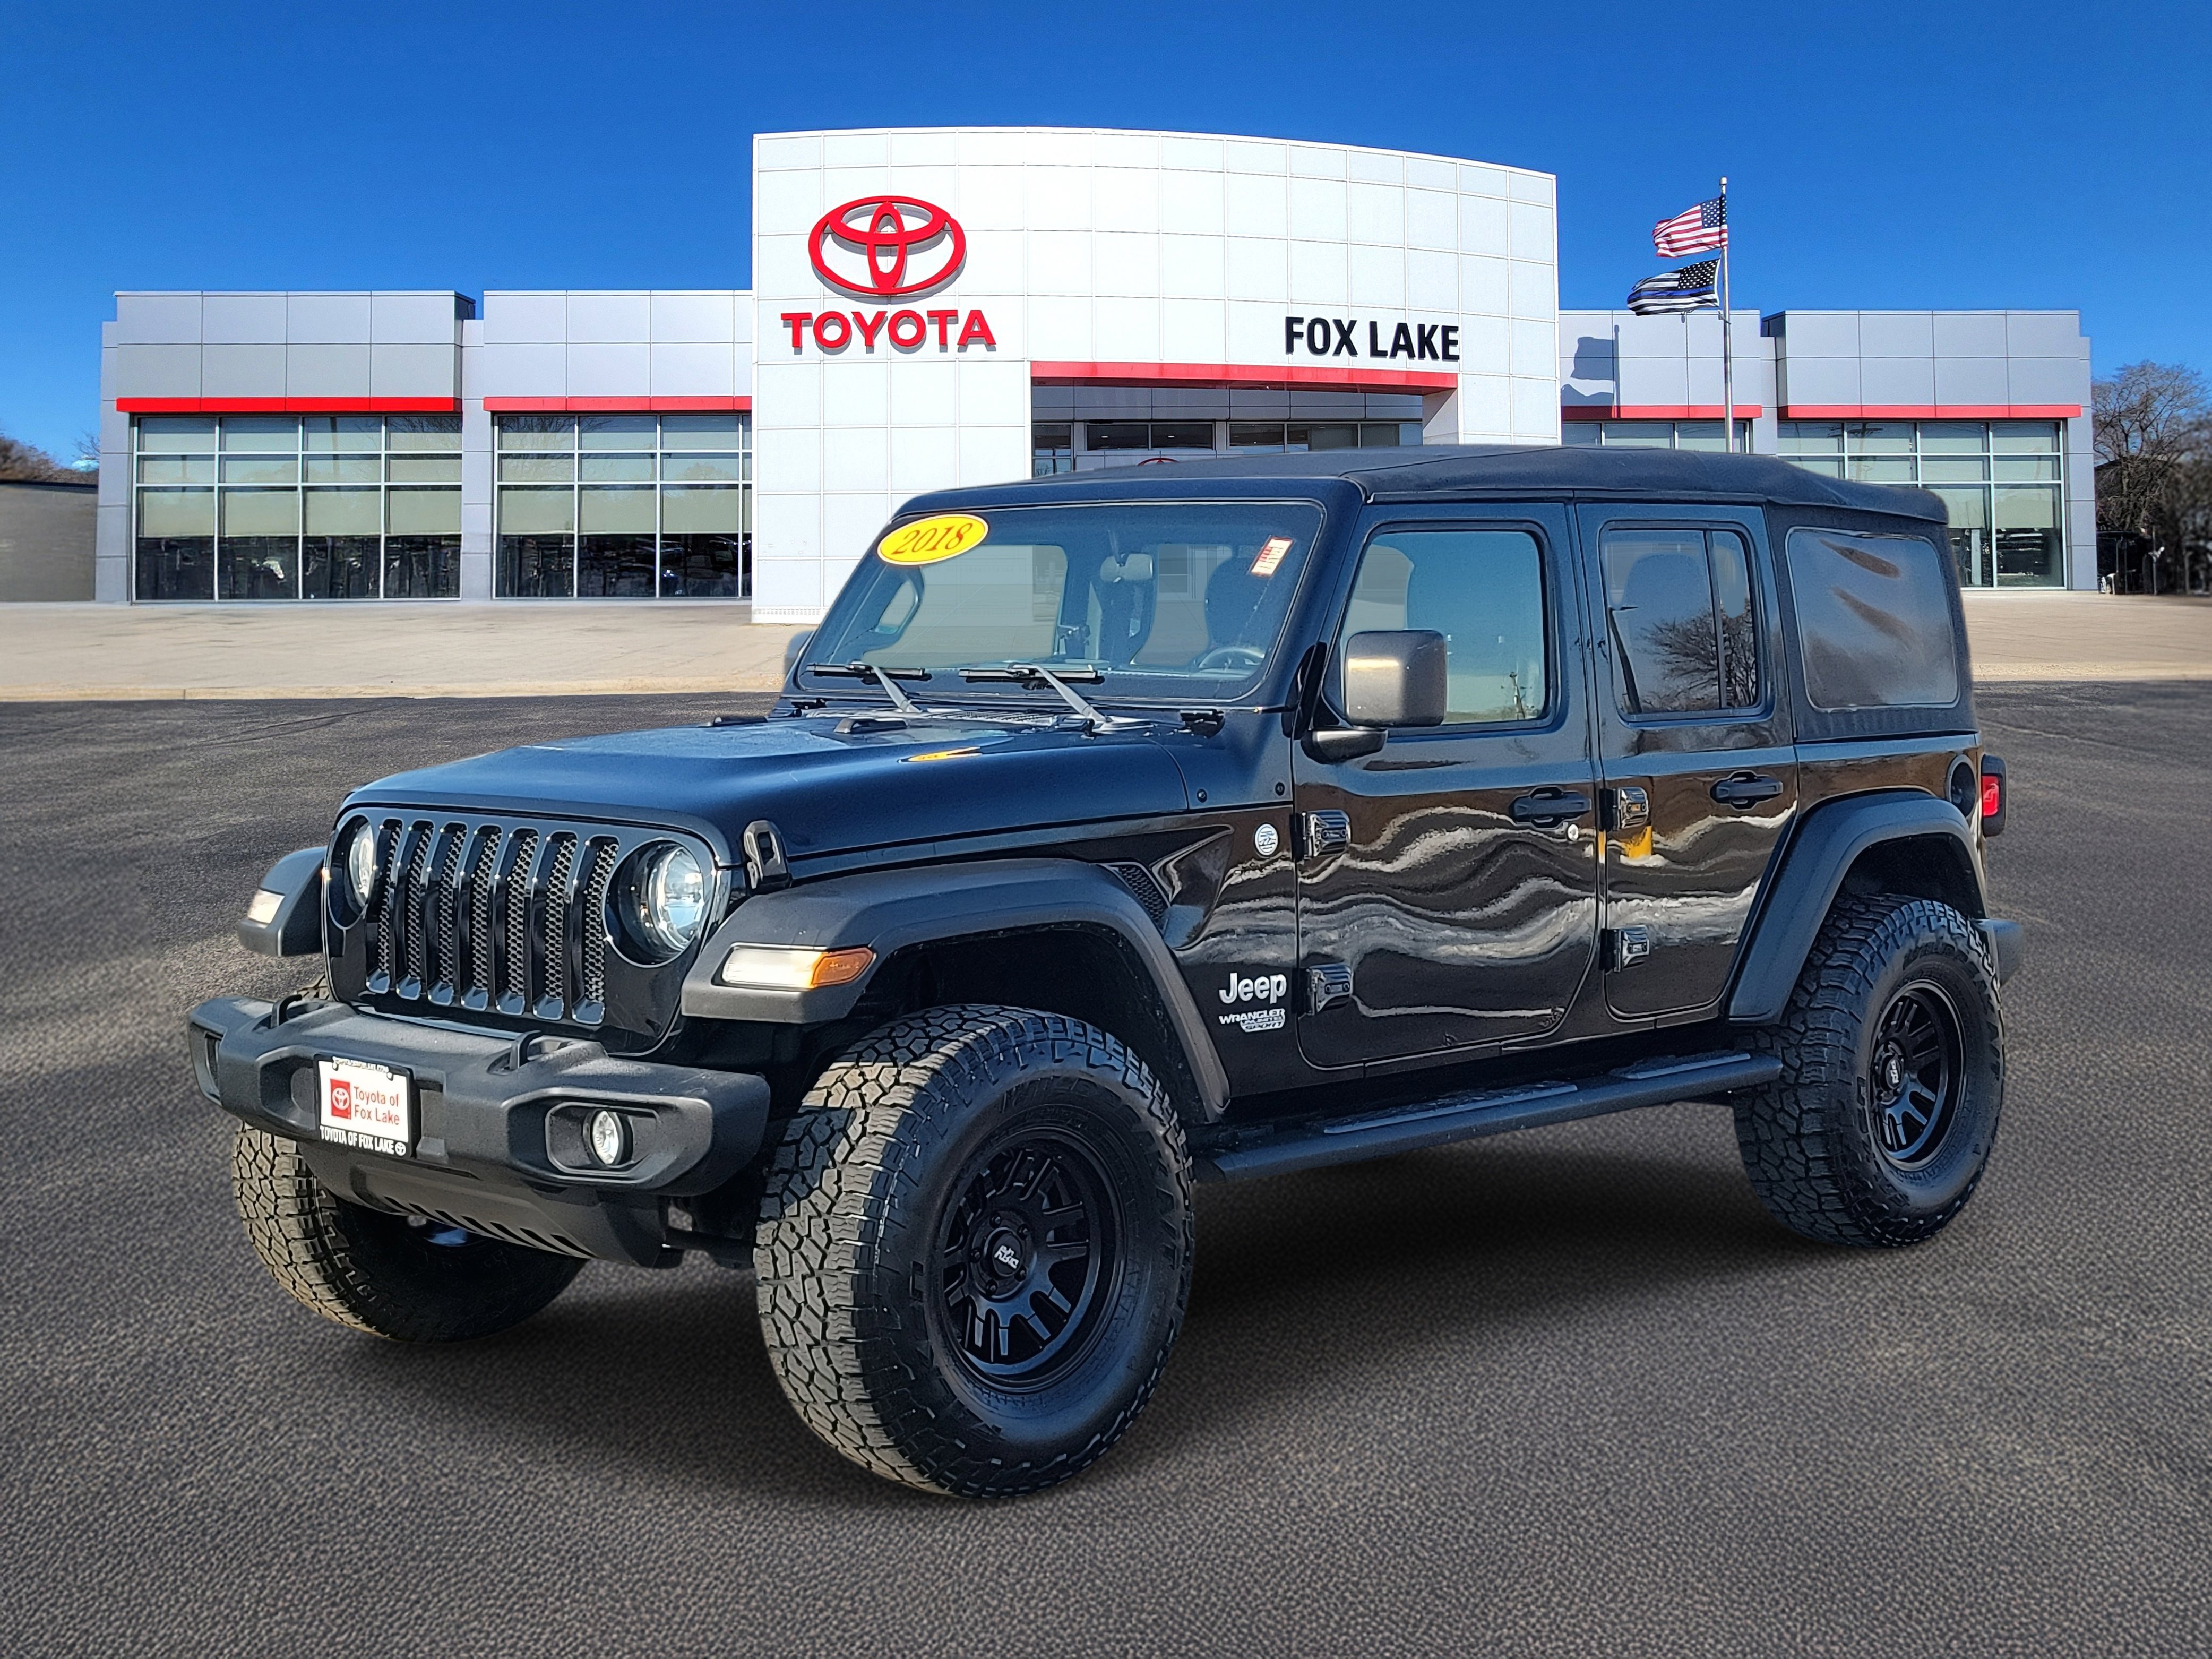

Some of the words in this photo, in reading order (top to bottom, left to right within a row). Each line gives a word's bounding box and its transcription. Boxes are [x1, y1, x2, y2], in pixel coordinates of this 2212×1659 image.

[781, 310, 997, 353] TOYOTA
[1285, 316, 1358, 356] FOX
[1368, 321, 1460, 361] LAKE
[891, 523, 973, 555] 2018
[1219, 972, 1287, 1004] Jeep
[1219, 1008, 1286, 1025] WRANGLER
[354, 1086, 386, 1105] Toyota
[390, 1093, 399, 1107] of
[354, 1105, 372, 1120] Fox
[375, 1108, 400, 1125] Lake
[320, 1125, 347, 1145] TOYOTA
[348, 1132, 358, 1147] OF
[358, 1134, 374, 1150] FOX
[374, 1137, 395, 1155] LAKE
